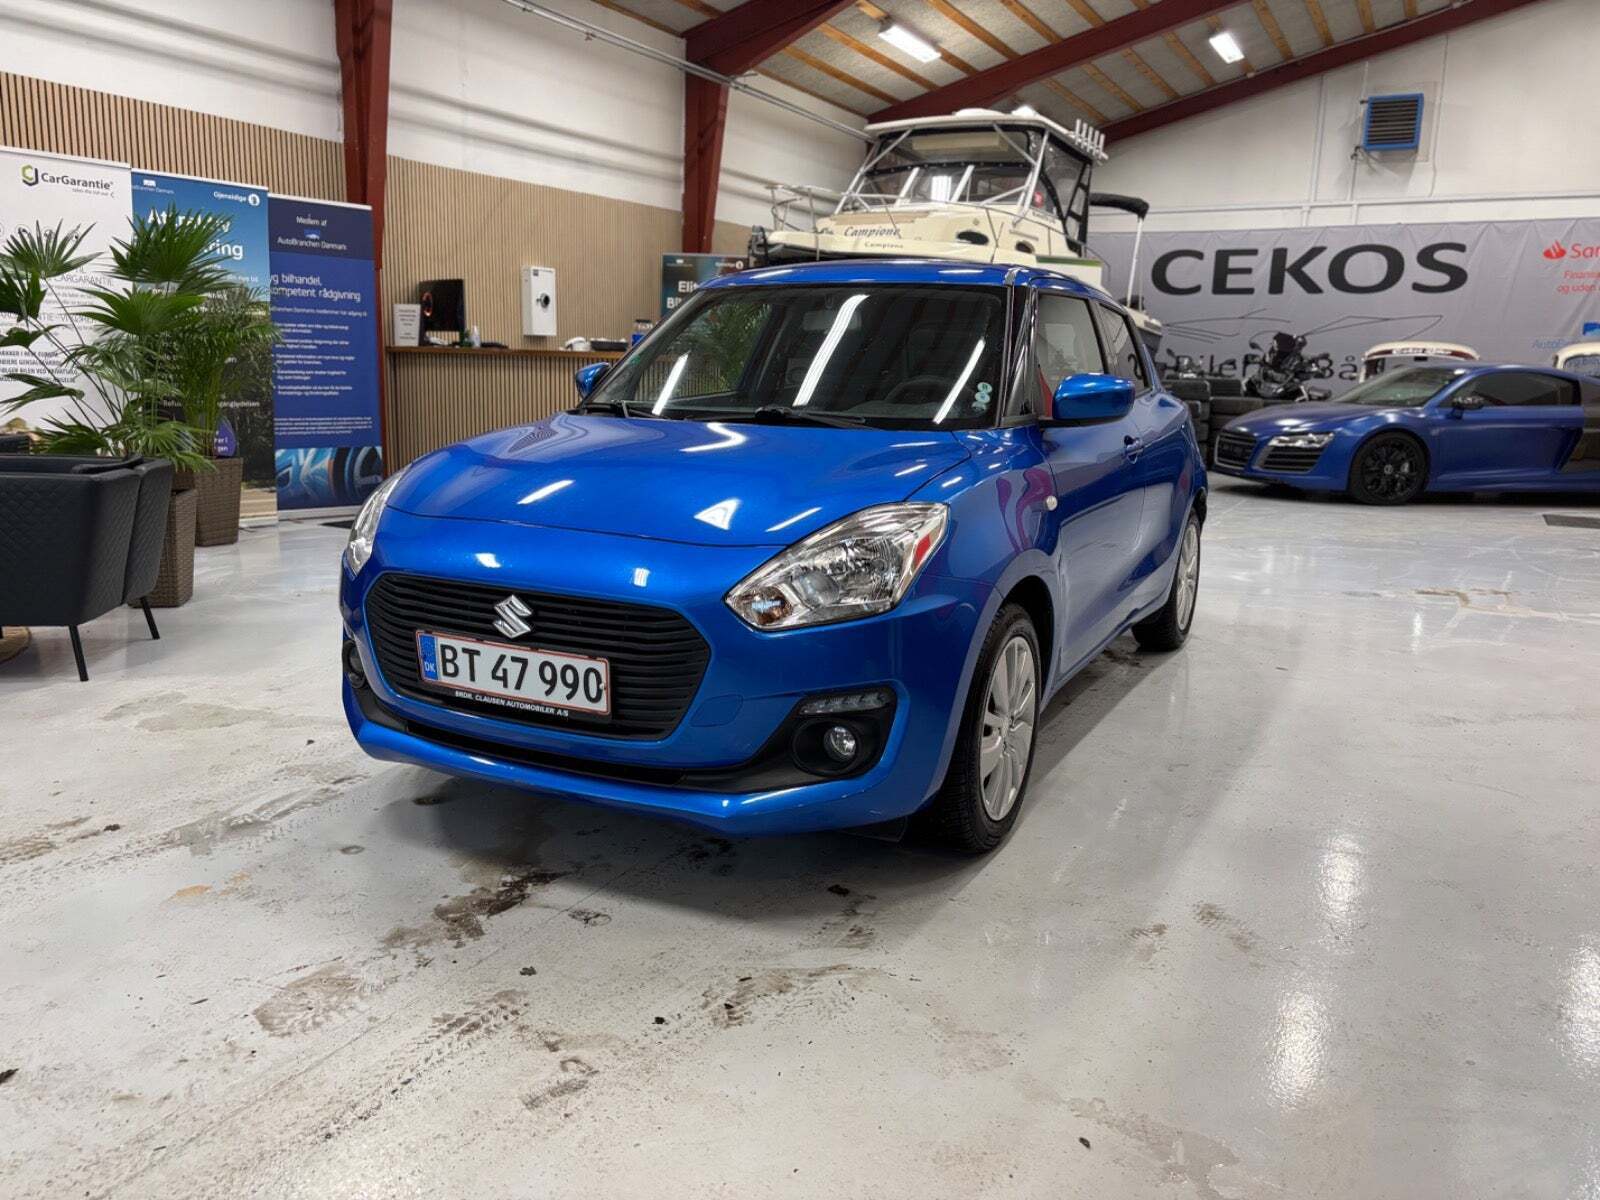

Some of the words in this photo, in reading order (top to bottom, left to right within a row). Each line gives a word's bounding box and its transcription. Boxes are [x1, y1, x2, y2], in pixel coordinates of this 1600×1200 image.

[41, 172, 111, 190] CarGarantie
[205, 239, 243, 261] ring
[1150, 242, 1469, 296] CEKOS
[424, 661, 436, 673] DK
[439, 643, 481, 683] BT
[491, 654, 529, 691] 47
[538, 660, 603, 704] 990
[475, 694, 505, 707] CLAUSEN
[506, 700, 555, 715] AUTOMOBILER
